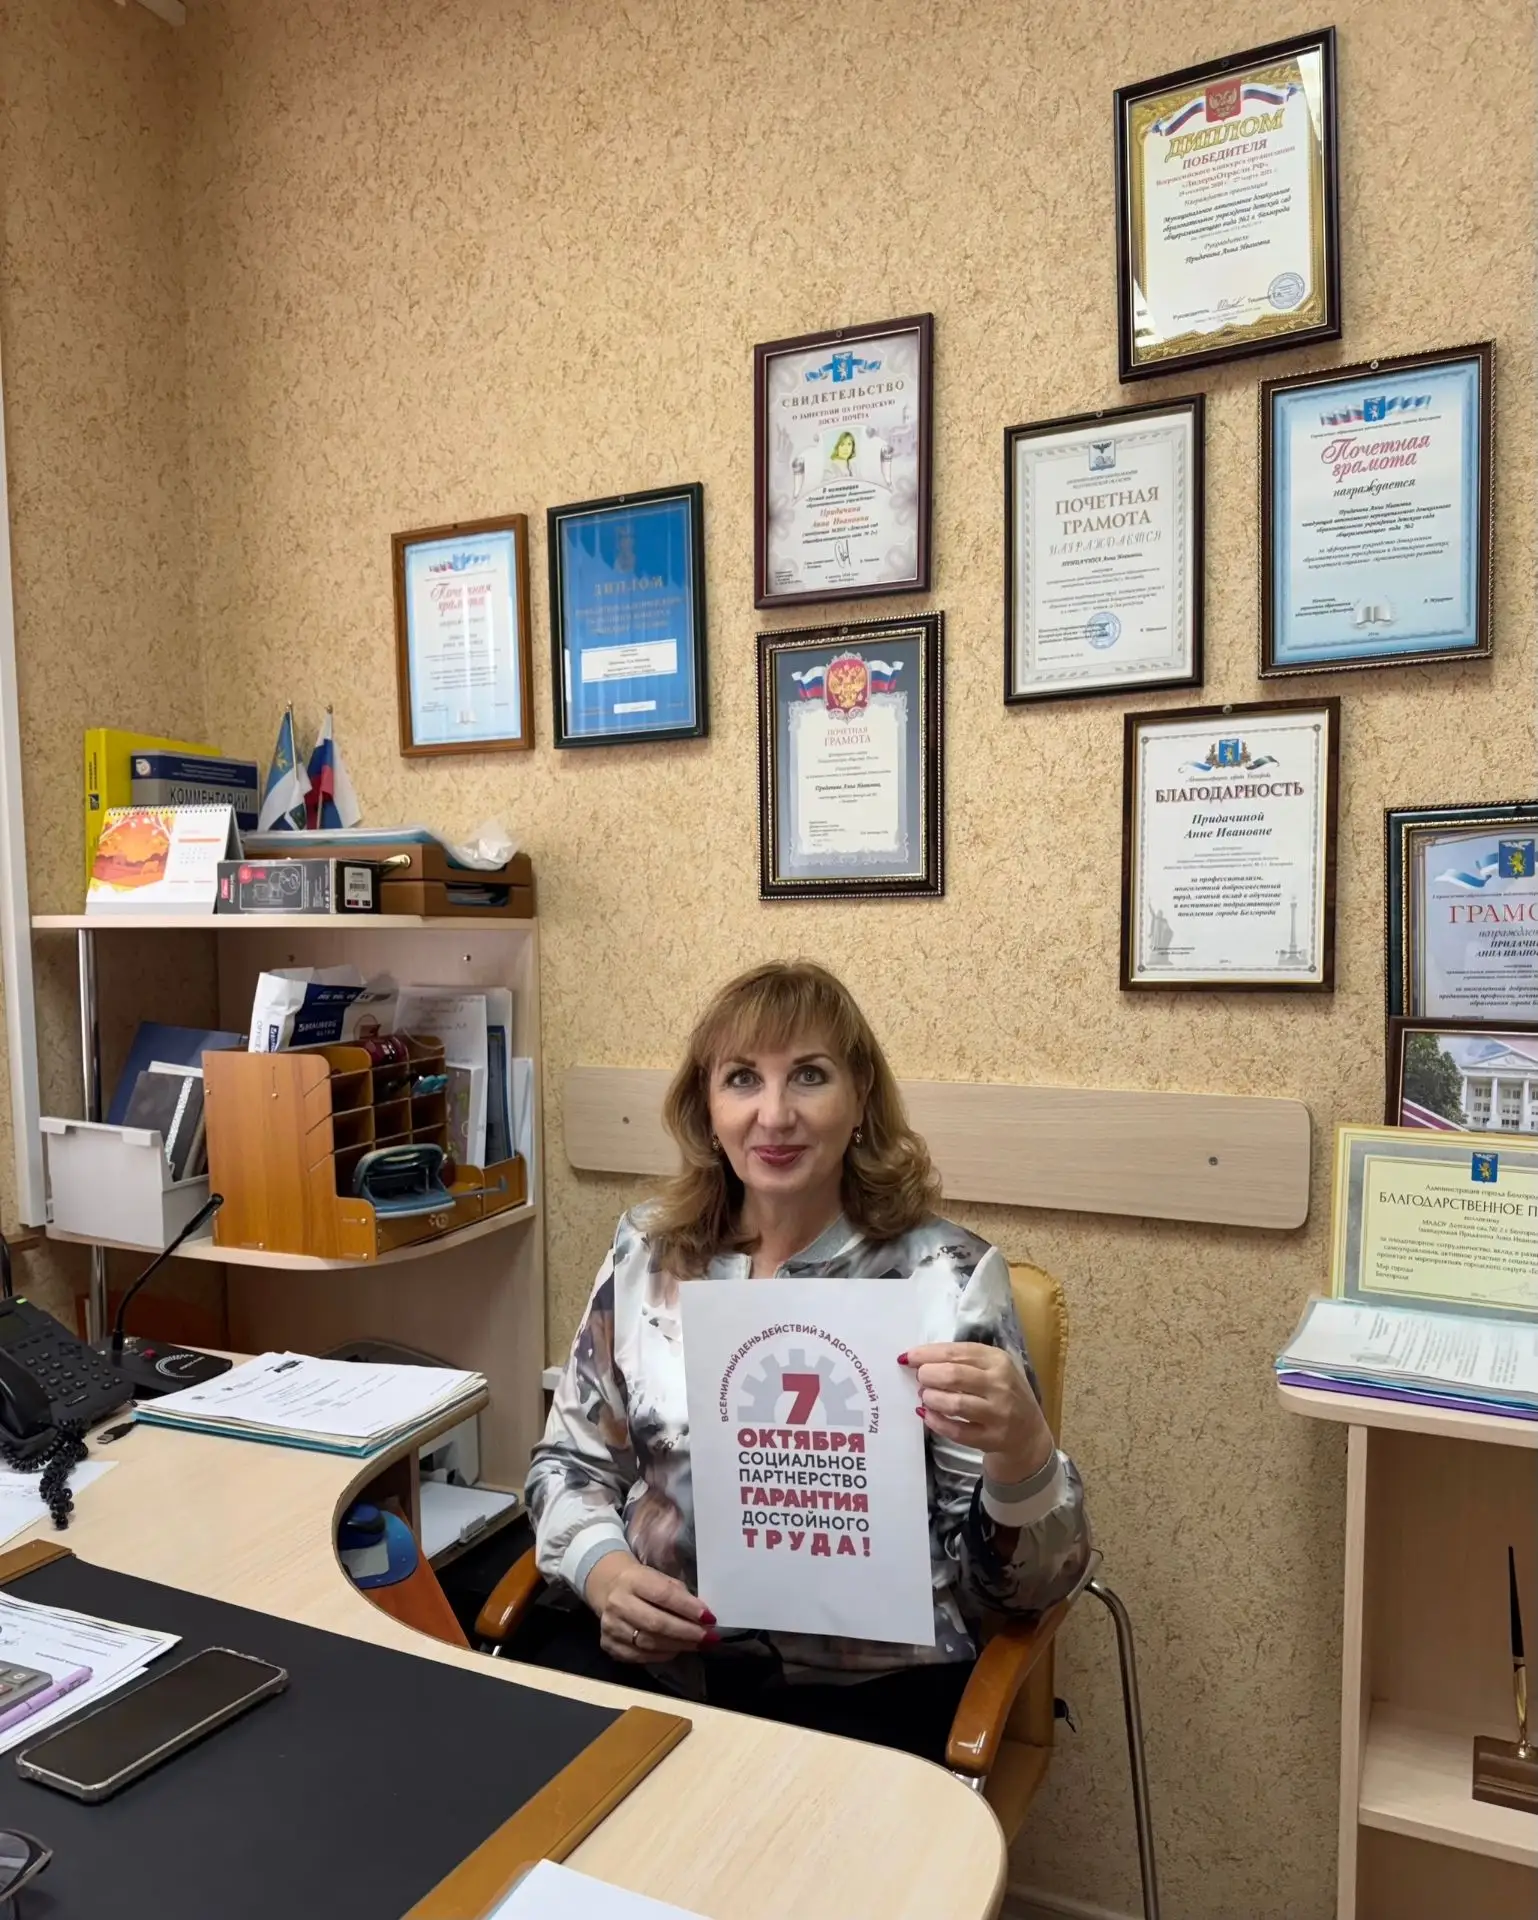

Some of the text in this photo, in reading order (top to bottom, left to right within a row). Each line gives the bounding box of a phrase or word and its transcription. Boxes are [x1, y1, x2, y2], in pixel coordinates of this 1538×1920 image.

[1165, 108, 1285, 163] ДИПЛОМ
[1182, 139, 1267, 170] ПОБЕДИТЕЛЯ
[782, 380, 905, 408] СВИДЕТЕЛЬСТВО
[1321, 434, 1431, 464] Почетная
[1332, 452, 1417, 484] грамота
[1055, 486, 1159, 516] ПОЧЕТНАЯ
[1333, 478, 1416, 500] награждается
[1062, 510, 1151, 535] ГРАМОТА
[824, 735, 871, 747] ГРАМОТА
[1156, 781, 1304, 804] БЛАГОДАРНОСТЬ
[1192, 812, 1265, 826] Придачиной
[1184, 827, 1272, 840] Анне Ивановне
[1379, 1192, 1524, 1216] БЛАГОДАРСТВЕННОЕ
[720, 1323, 880, 1435] ВСЕМИРНЫЙ ДЕНЬ ДЕЙСТВИЙ ЗА ДОСТОЙНЫЙ ТРУД
[781, 1373, 821, 1425] 7
[737, 1428, 866, 1453] ОКТЯБРЯ
[738, 1451, 867, 1471] СОЦИАЛЬНОЕ
[739, 1469, 868, 1489] ПАРТНЕРСТВО
[740, 1486, 869, 1513] ГАРАНТИЯ
[741, 1510, 870, 1532] ДОСТОЙНОГО
[742, 1528, 871, 1557] ТРУДА!
